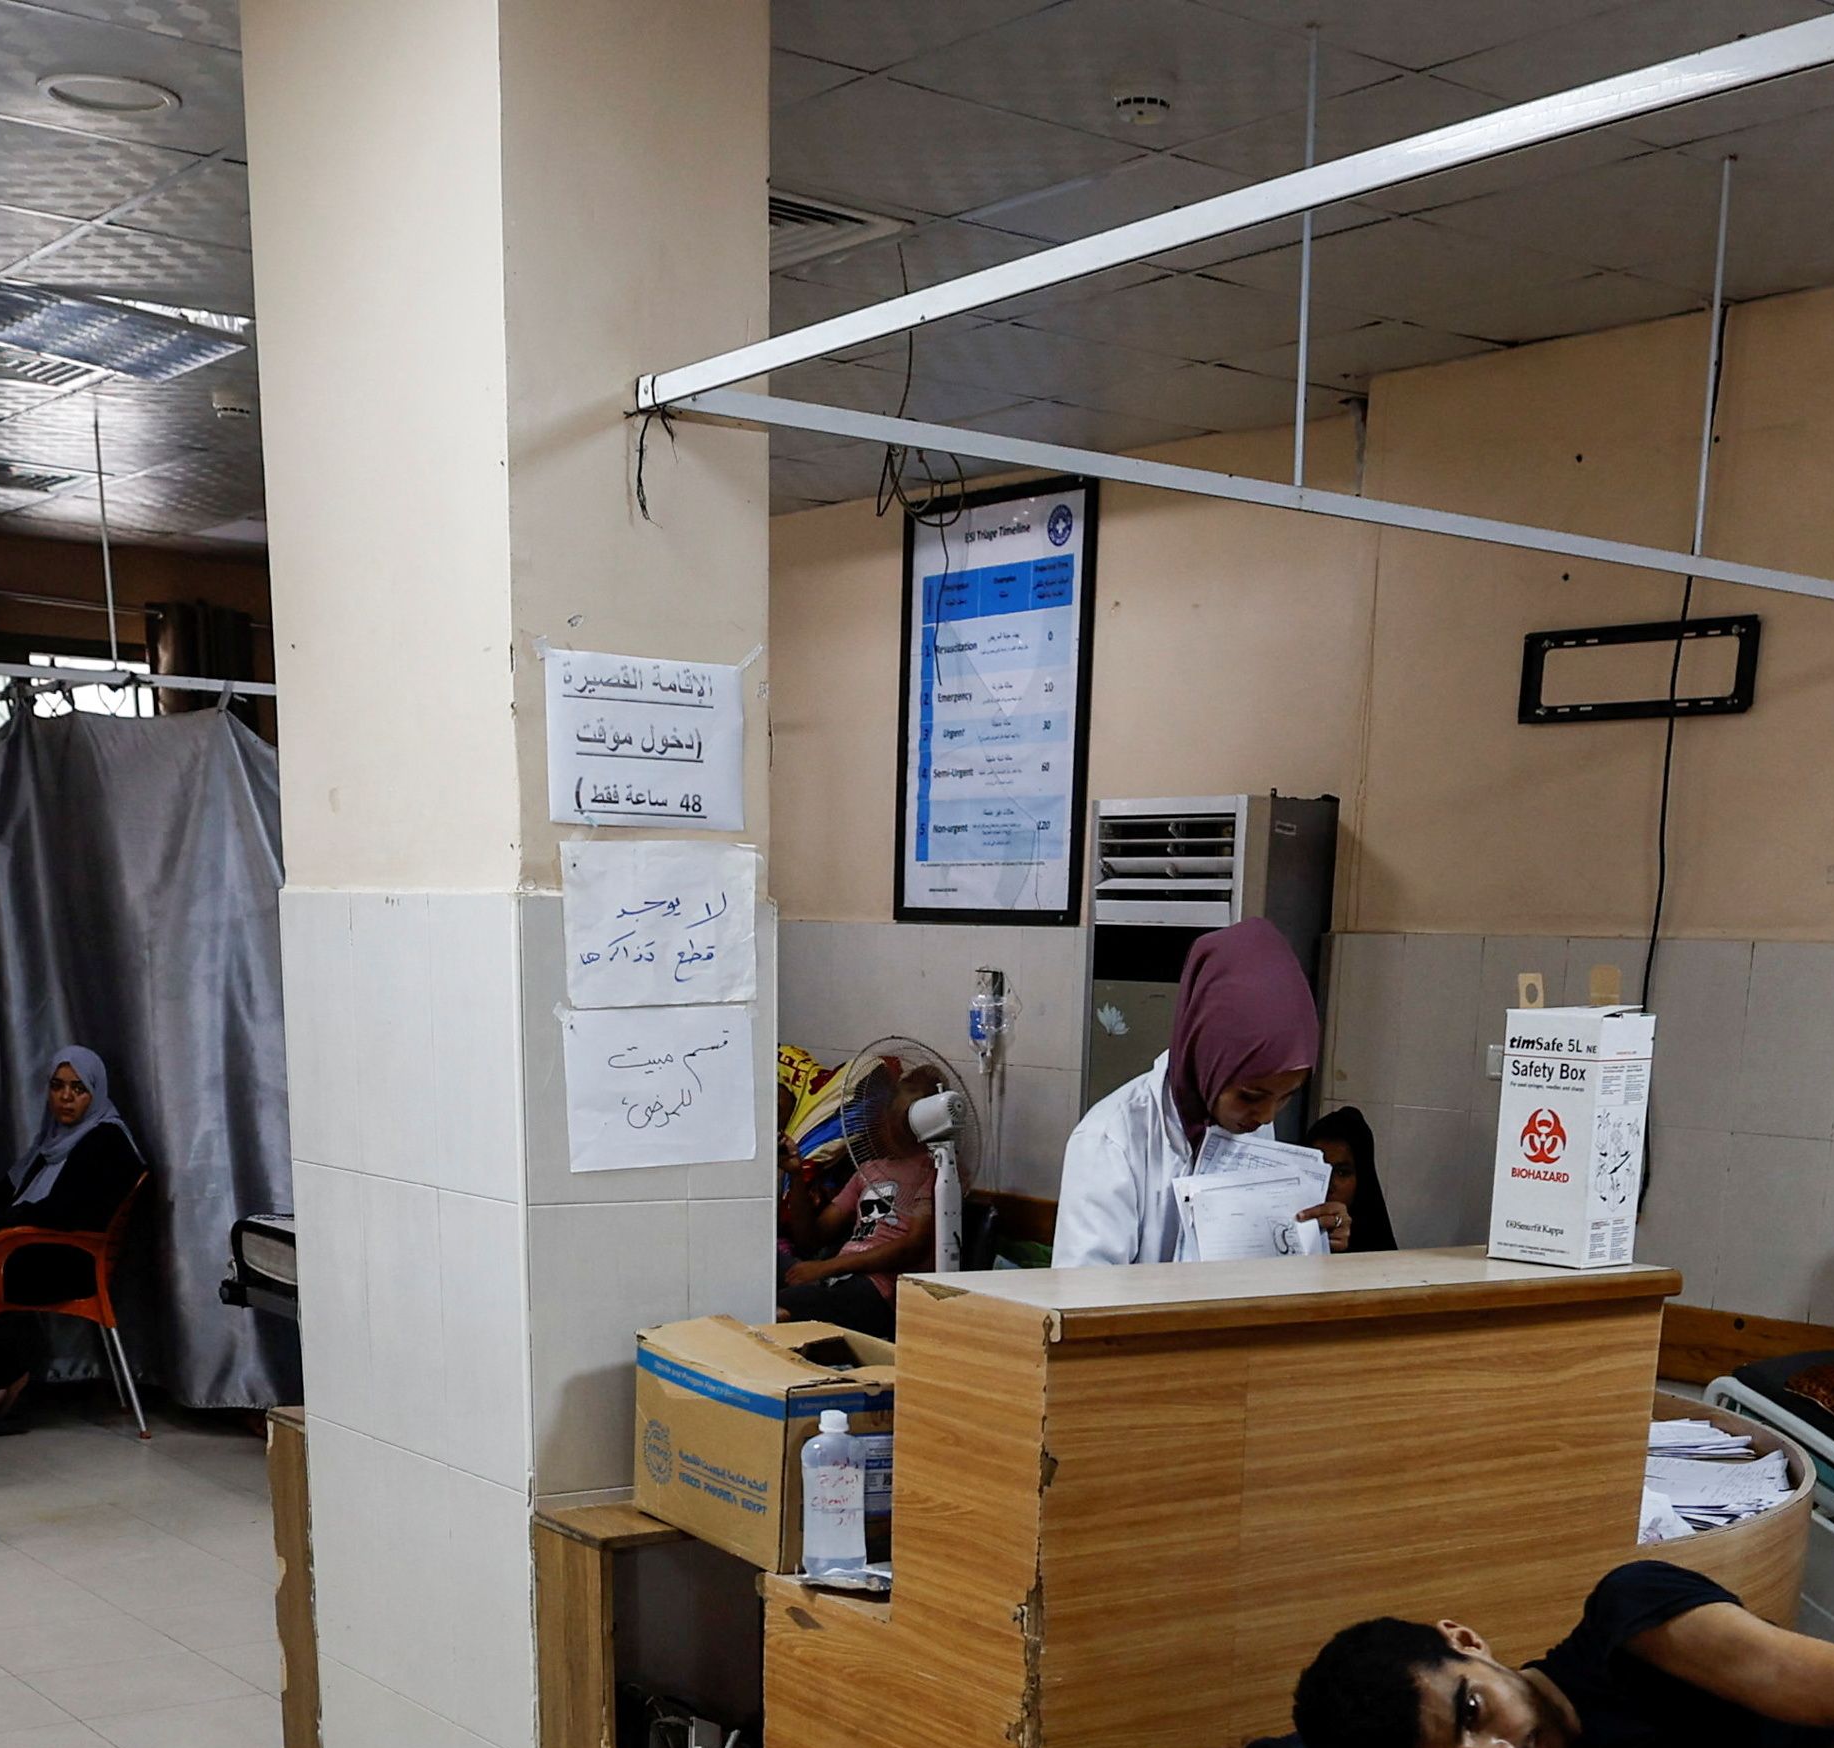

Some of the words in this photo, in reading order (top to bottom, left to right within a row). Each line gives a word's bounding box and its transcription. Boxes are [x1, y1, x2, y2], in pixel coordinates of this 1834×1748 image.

[977, 528, 998, 542] Triage
[998, 522, 1031, 537] Timeline
[1047, 631, 1054, 641] 0
[563, 661, 643, 694] القصيرة
[652, 664, 713, 704] الإقامة
[938, 692, 972, 703] Emergency
[1044, 682, 1054, 693] 10
[576, 717, 633, 752] مؤقت
[943, 728, 965, 740] Urgent
[933, 768, 974, 779] Semi-Urgent
[1041, 762, 1050, 772] 60
[625, 784, 668, 807] ساعة
[679, 793, 702, 814] 48
[932, 823, 968, 835] Non-urgent
[616, 897, 681, 922] يوجد
[685, 891, 727, 930] لا
[674, 939, 716, 983] قطع
[1509, 1036, 1564, 1052] timSafe
[1567, 1038, 1583, 1053] 5L
[1586, 1045, 1598, 1054] NE
[607, 1046, 674, 1075] مبيت
[683, 1029, 730, 1094] قسم
[1511, 1059, 1555, 1082] Safety
[1559, 1063, 1587, 1081] Box
[1511, 1167, 1570, 1184] BIOHAZARD
[1542, 1224, 1564, 1237] Kappa
